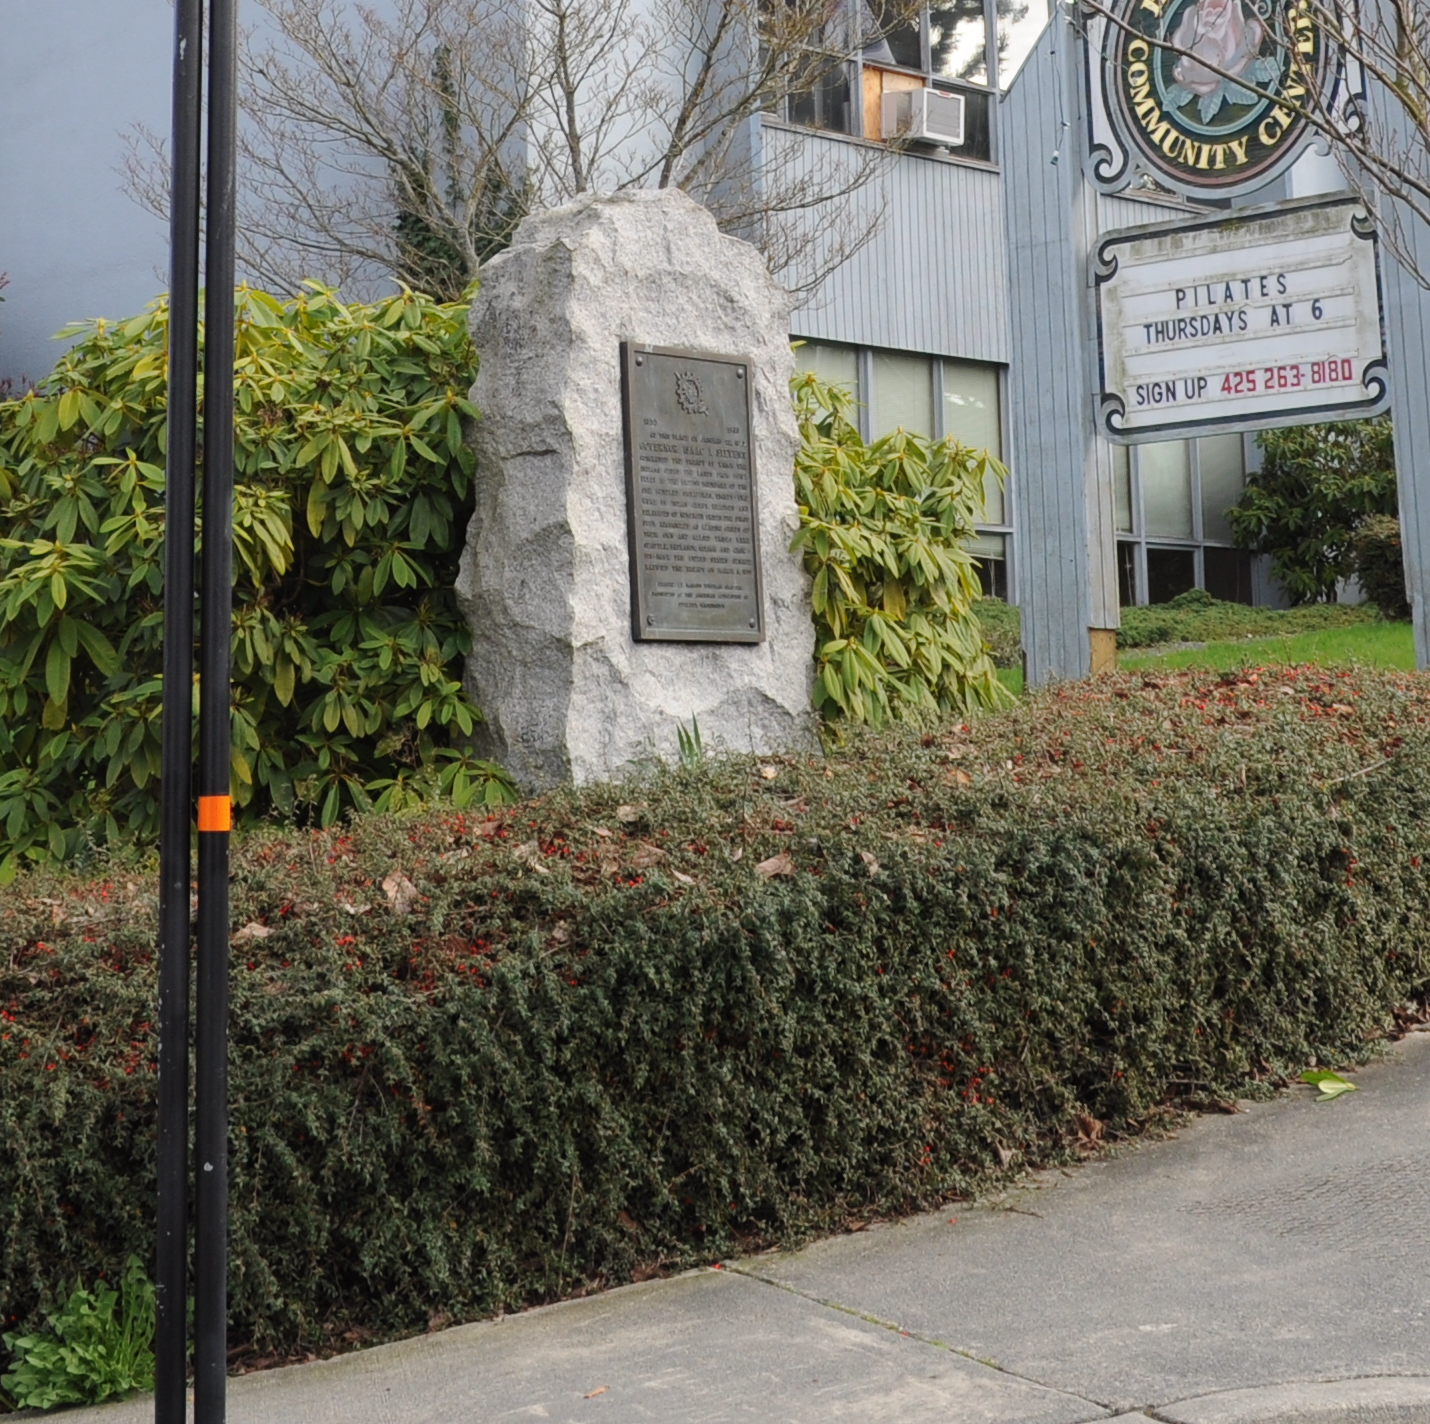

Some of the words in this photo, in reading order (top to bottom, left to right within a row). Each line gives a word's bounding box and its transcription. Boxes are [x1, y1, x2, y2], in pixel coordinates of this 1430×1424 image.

[1128, 39, 1250, 170] COMMUNITY
[1175, 273, 1287, 310] PILATES
[1143, 310, 1248, 345] THURSDAYS
[1270, 303, 1293, 326] AT
[1311, 299, 1323, 321] 6
[1136, 381, 1177, 406] SIGN
[1184, 377, 1208, 399] UP
[1221, 370, 1256, 395] 425
